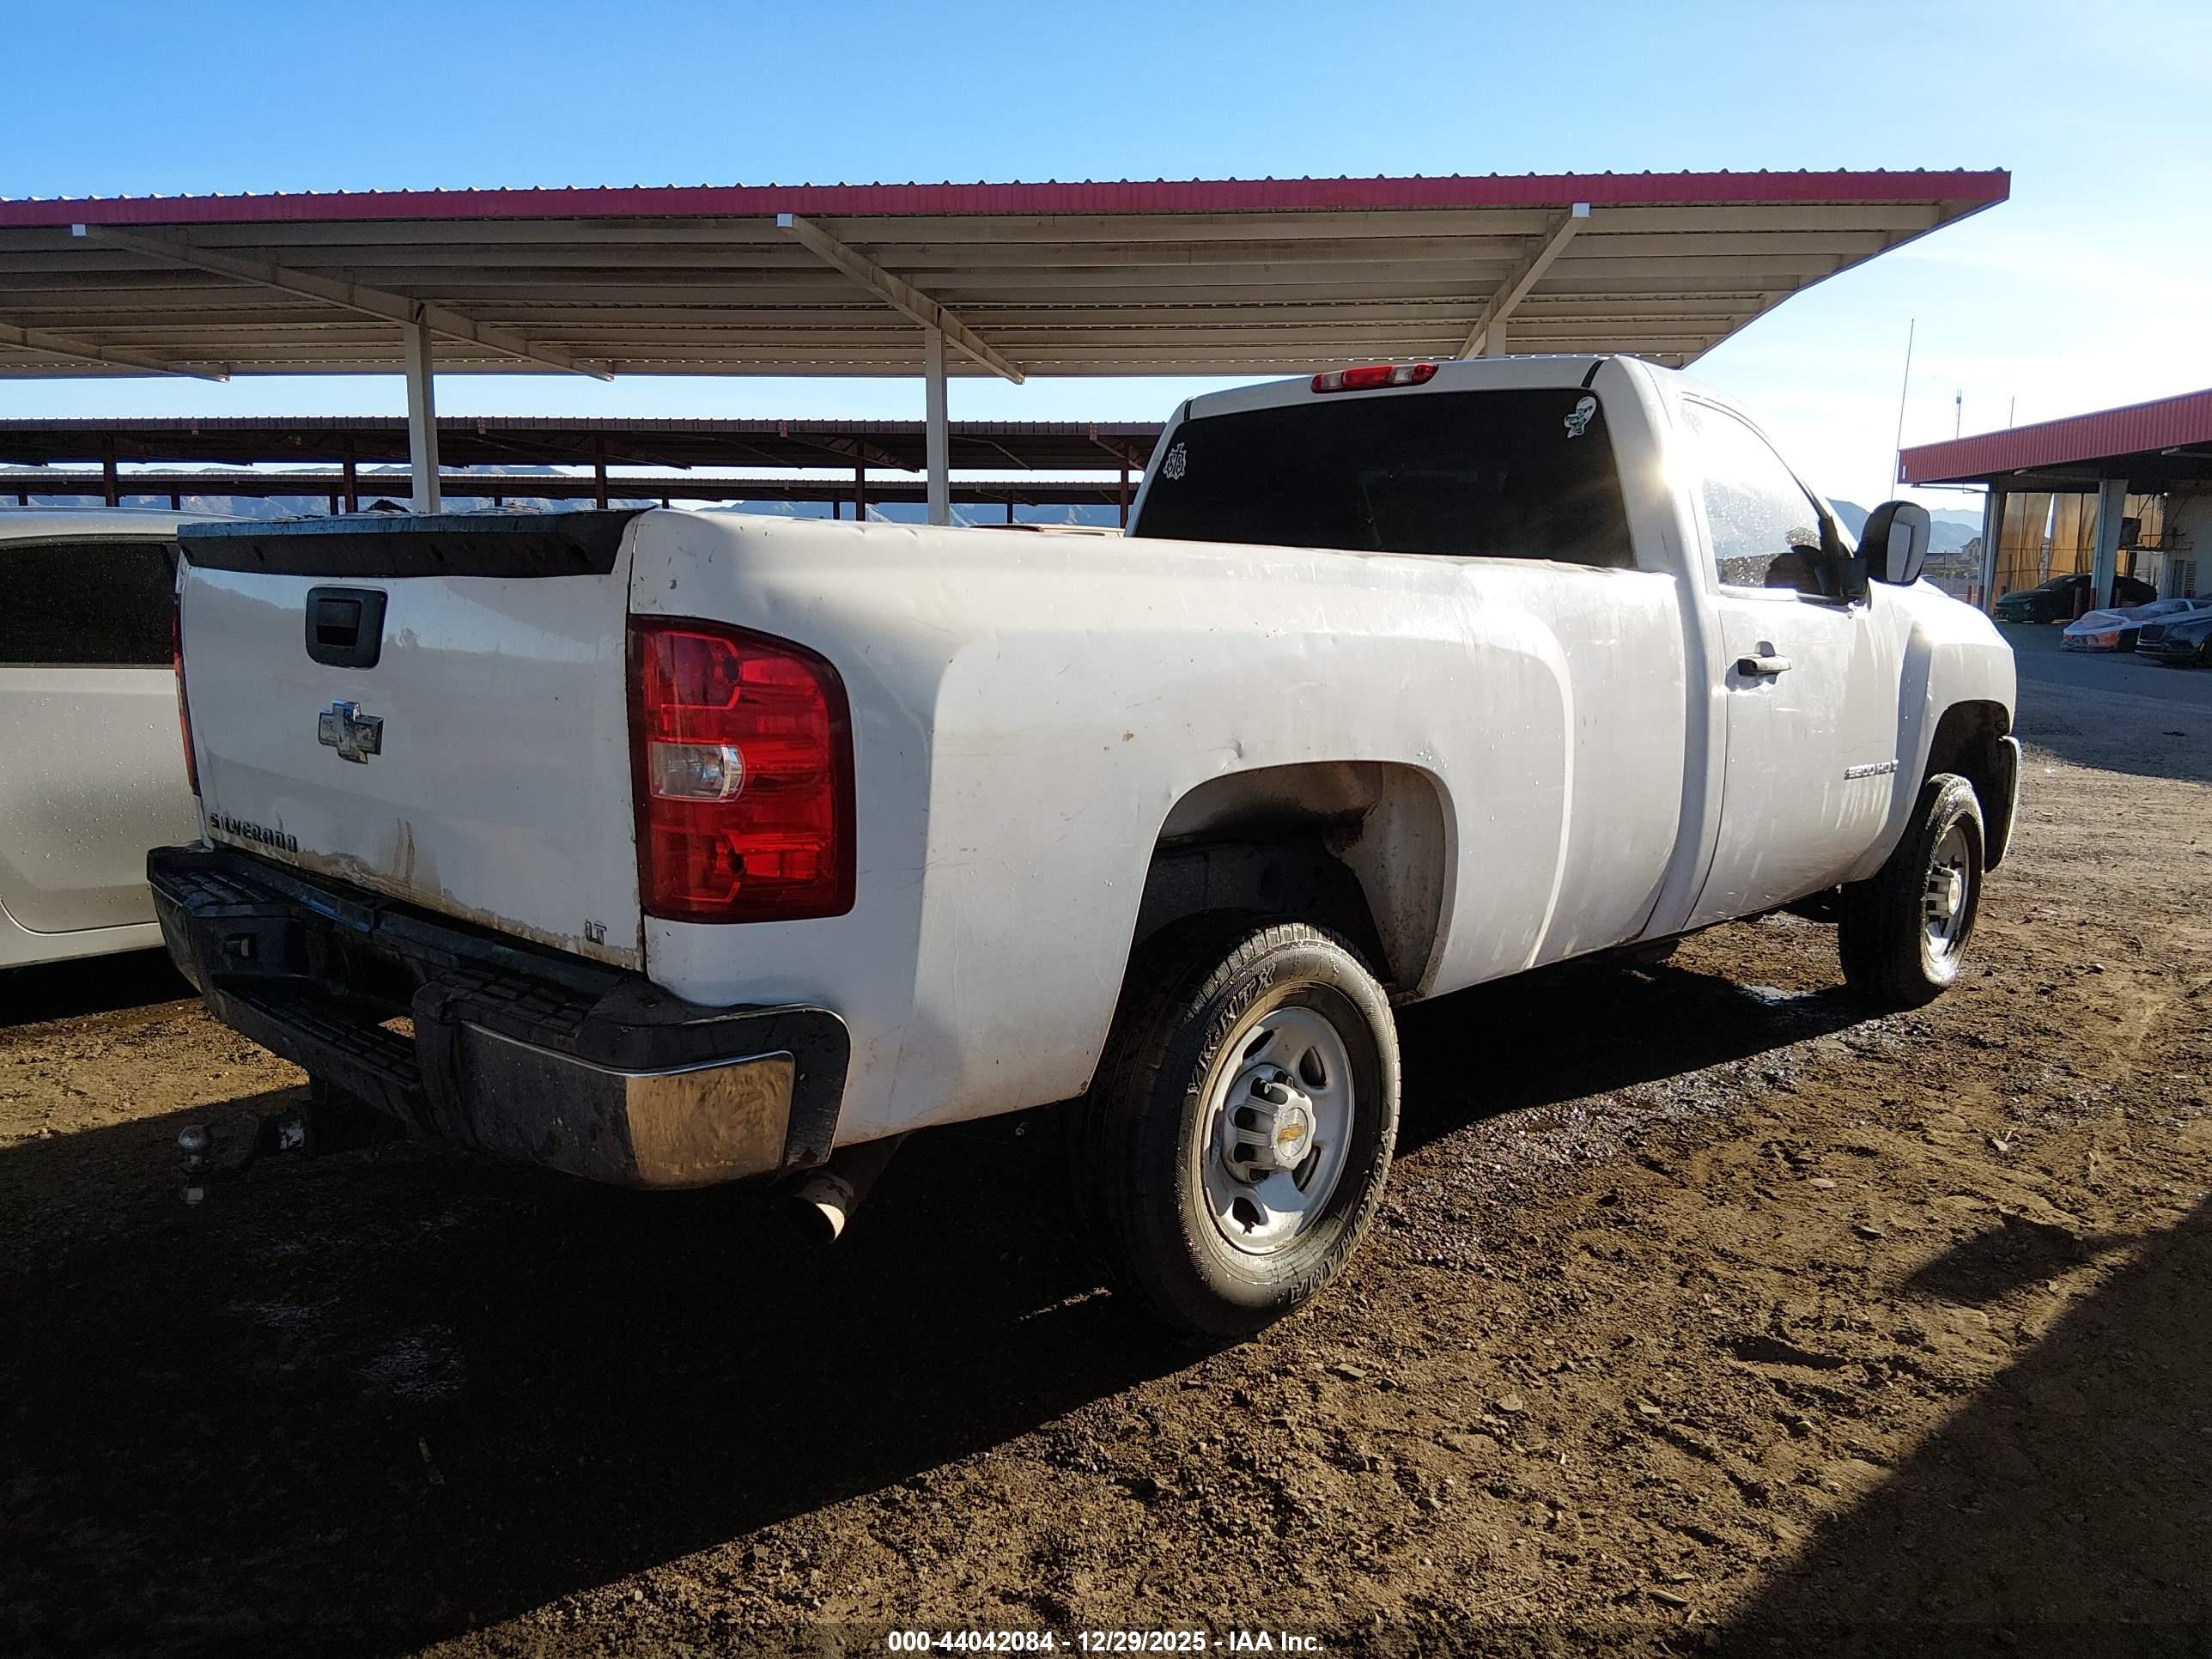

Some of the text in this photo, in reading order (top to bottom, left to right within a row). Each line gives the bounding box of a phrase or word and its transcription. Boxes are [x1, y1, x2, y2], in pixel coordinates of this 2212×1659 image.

[210, 812, 298, 853] SILVERADO
[585, 921, 607, 945] LT
[1291, 1127, 1392, 1304] YOKOHAMA
